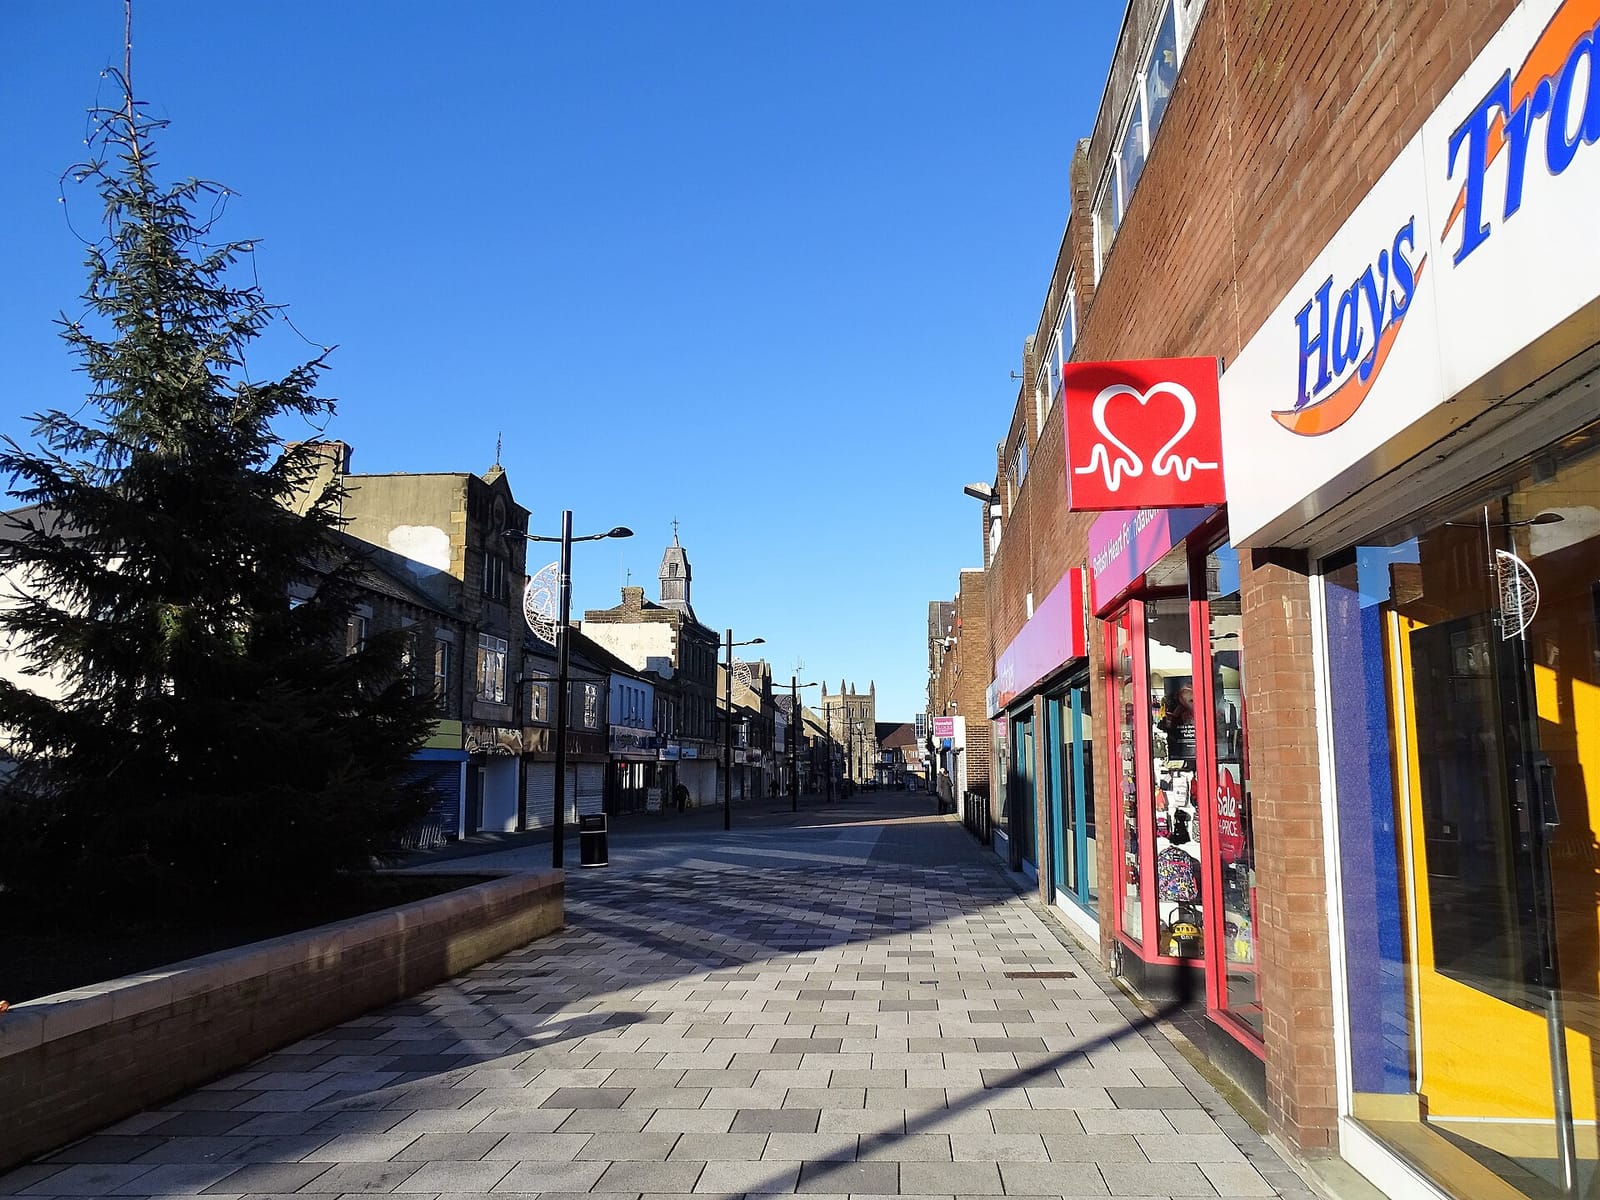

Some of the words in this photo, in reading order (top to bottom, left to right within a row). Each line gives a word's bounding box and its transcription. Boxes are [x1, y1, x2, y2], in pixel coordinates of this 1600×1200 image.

[1294, 214, 1416, 413] Hays
[1446, 19, 1600, 269] Tra
[1092, 545, 1109, 579] British
[1107, 529, 1123, 565] Heart
[1217, 786, 1236, 818] Sale
